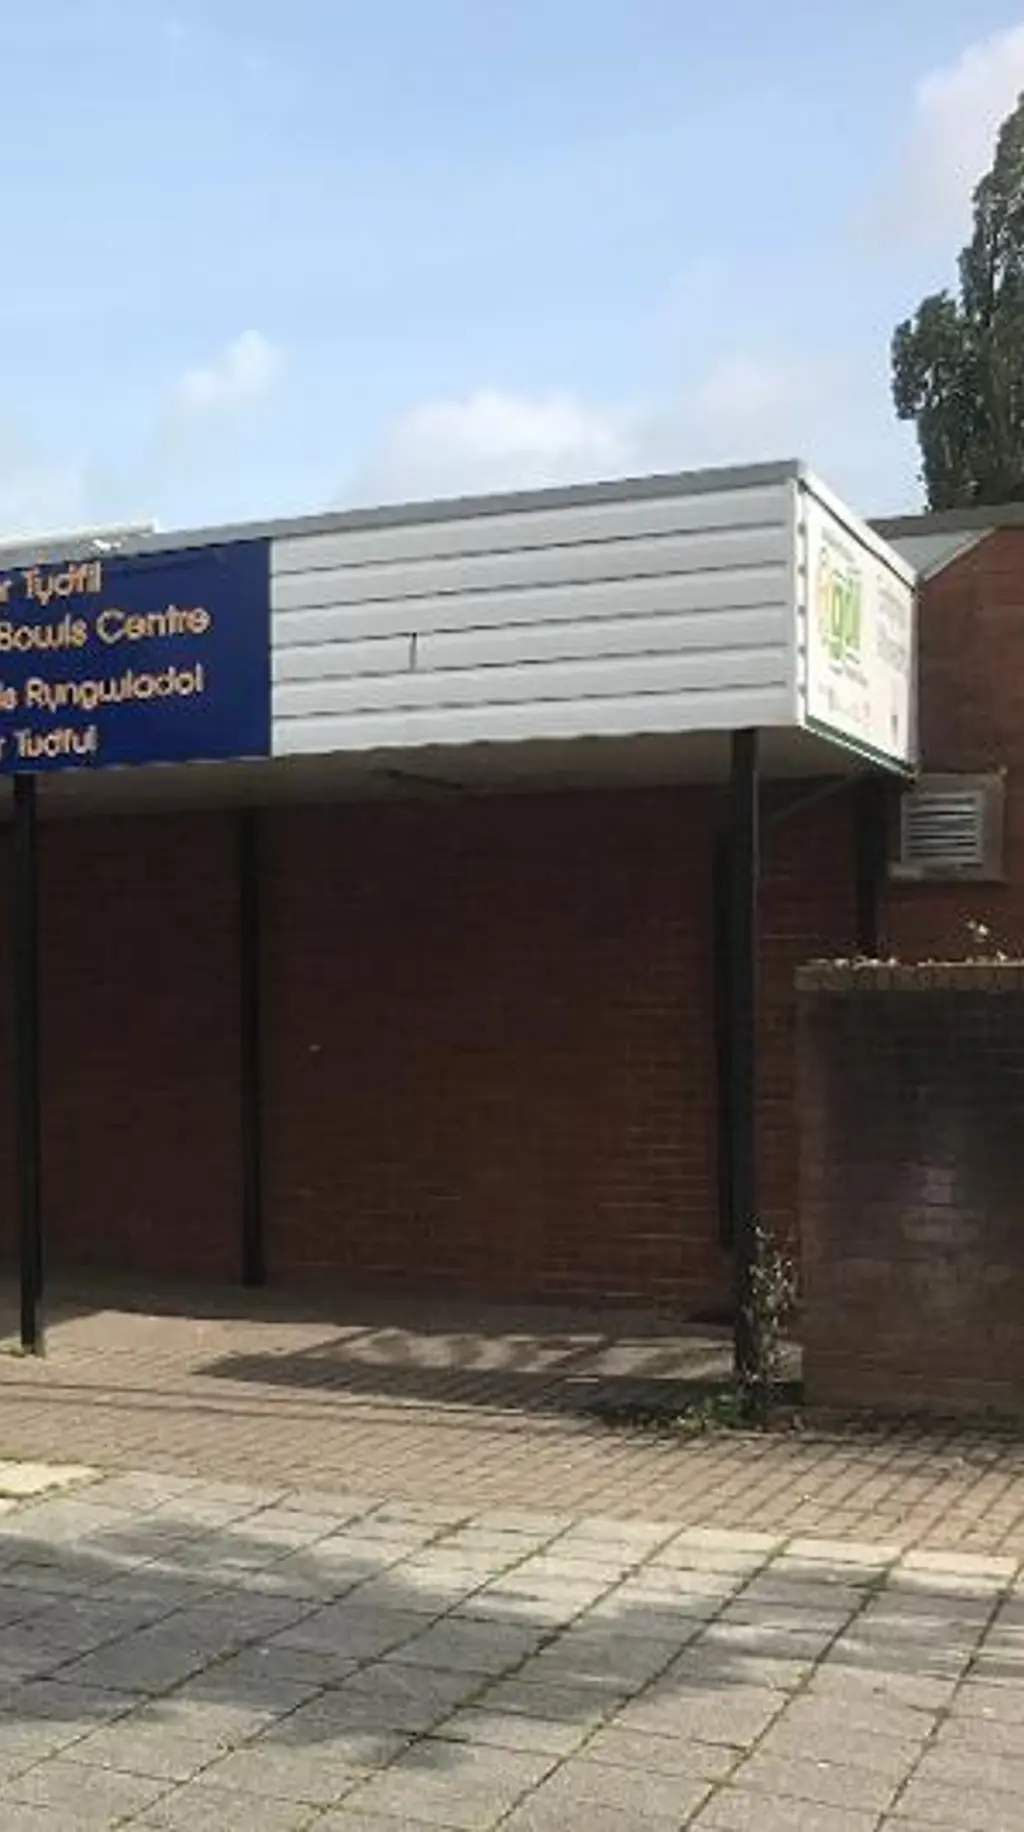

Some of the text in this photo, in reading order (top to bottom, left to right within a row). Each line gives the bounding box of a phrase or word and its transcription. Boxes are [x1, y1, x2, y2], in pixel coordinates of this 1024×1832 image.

[23, 561, 103, 605] Tydfil
[96, 605, 211, 644] Centre
[26, 664, 205, 713] Ryngwladol
[14, 725, 98, 758] Tudful
